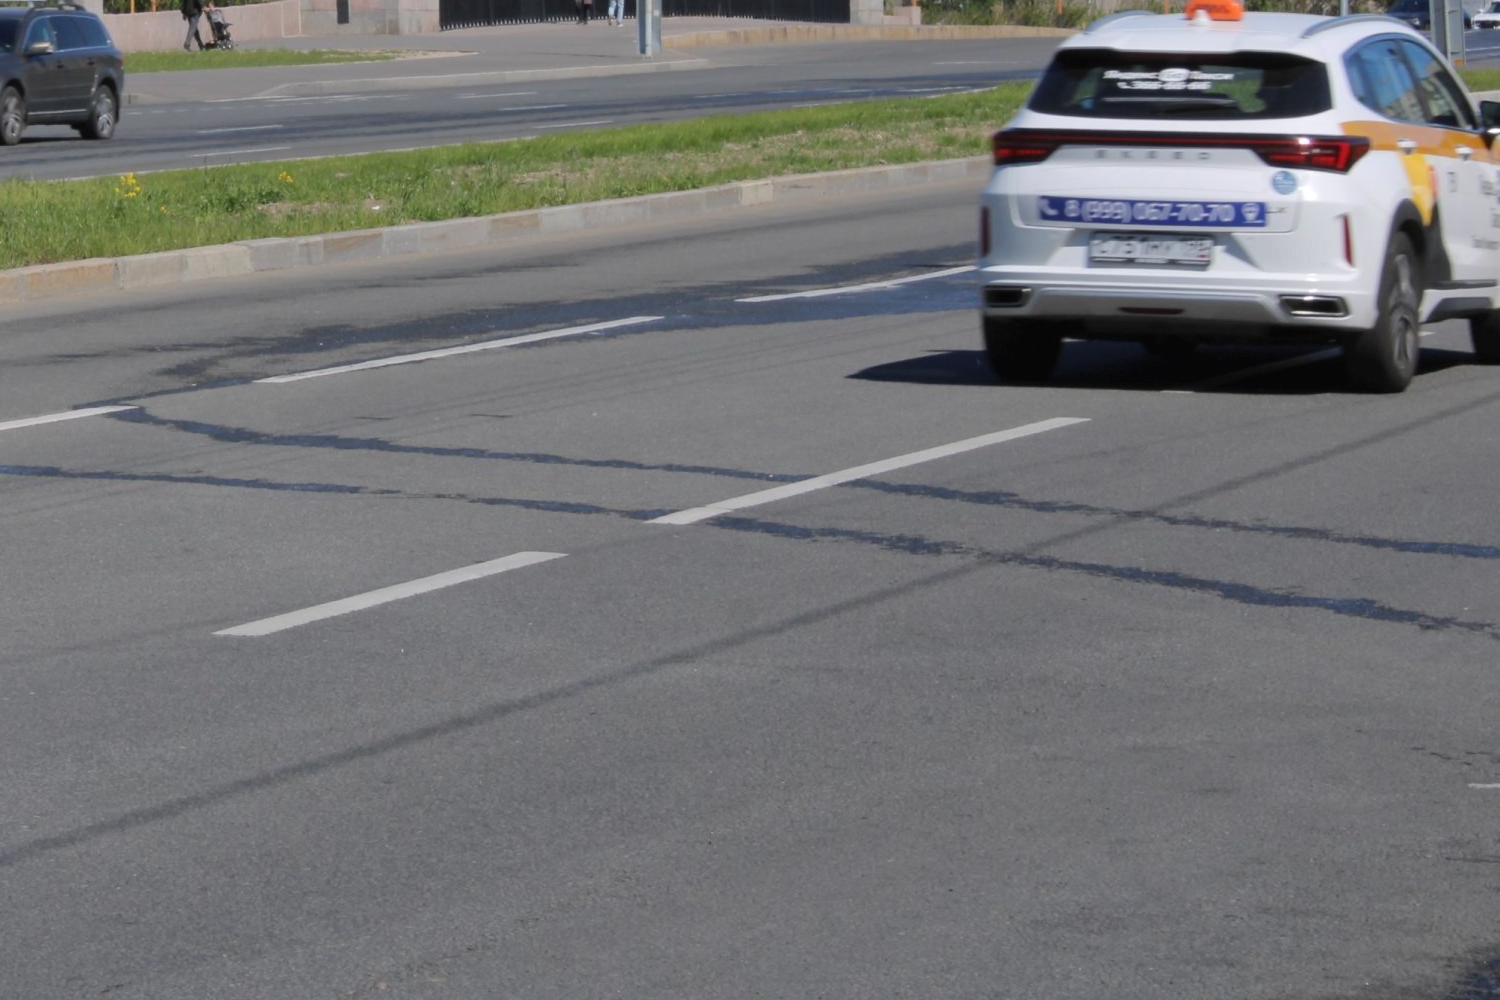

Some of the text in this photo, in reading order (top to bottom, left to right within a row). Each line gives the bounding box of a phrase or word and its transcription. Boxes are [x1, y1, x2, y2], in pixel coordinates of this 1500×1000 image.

[1064, 199, 1235, 224] 8 (999) 067-70-70
